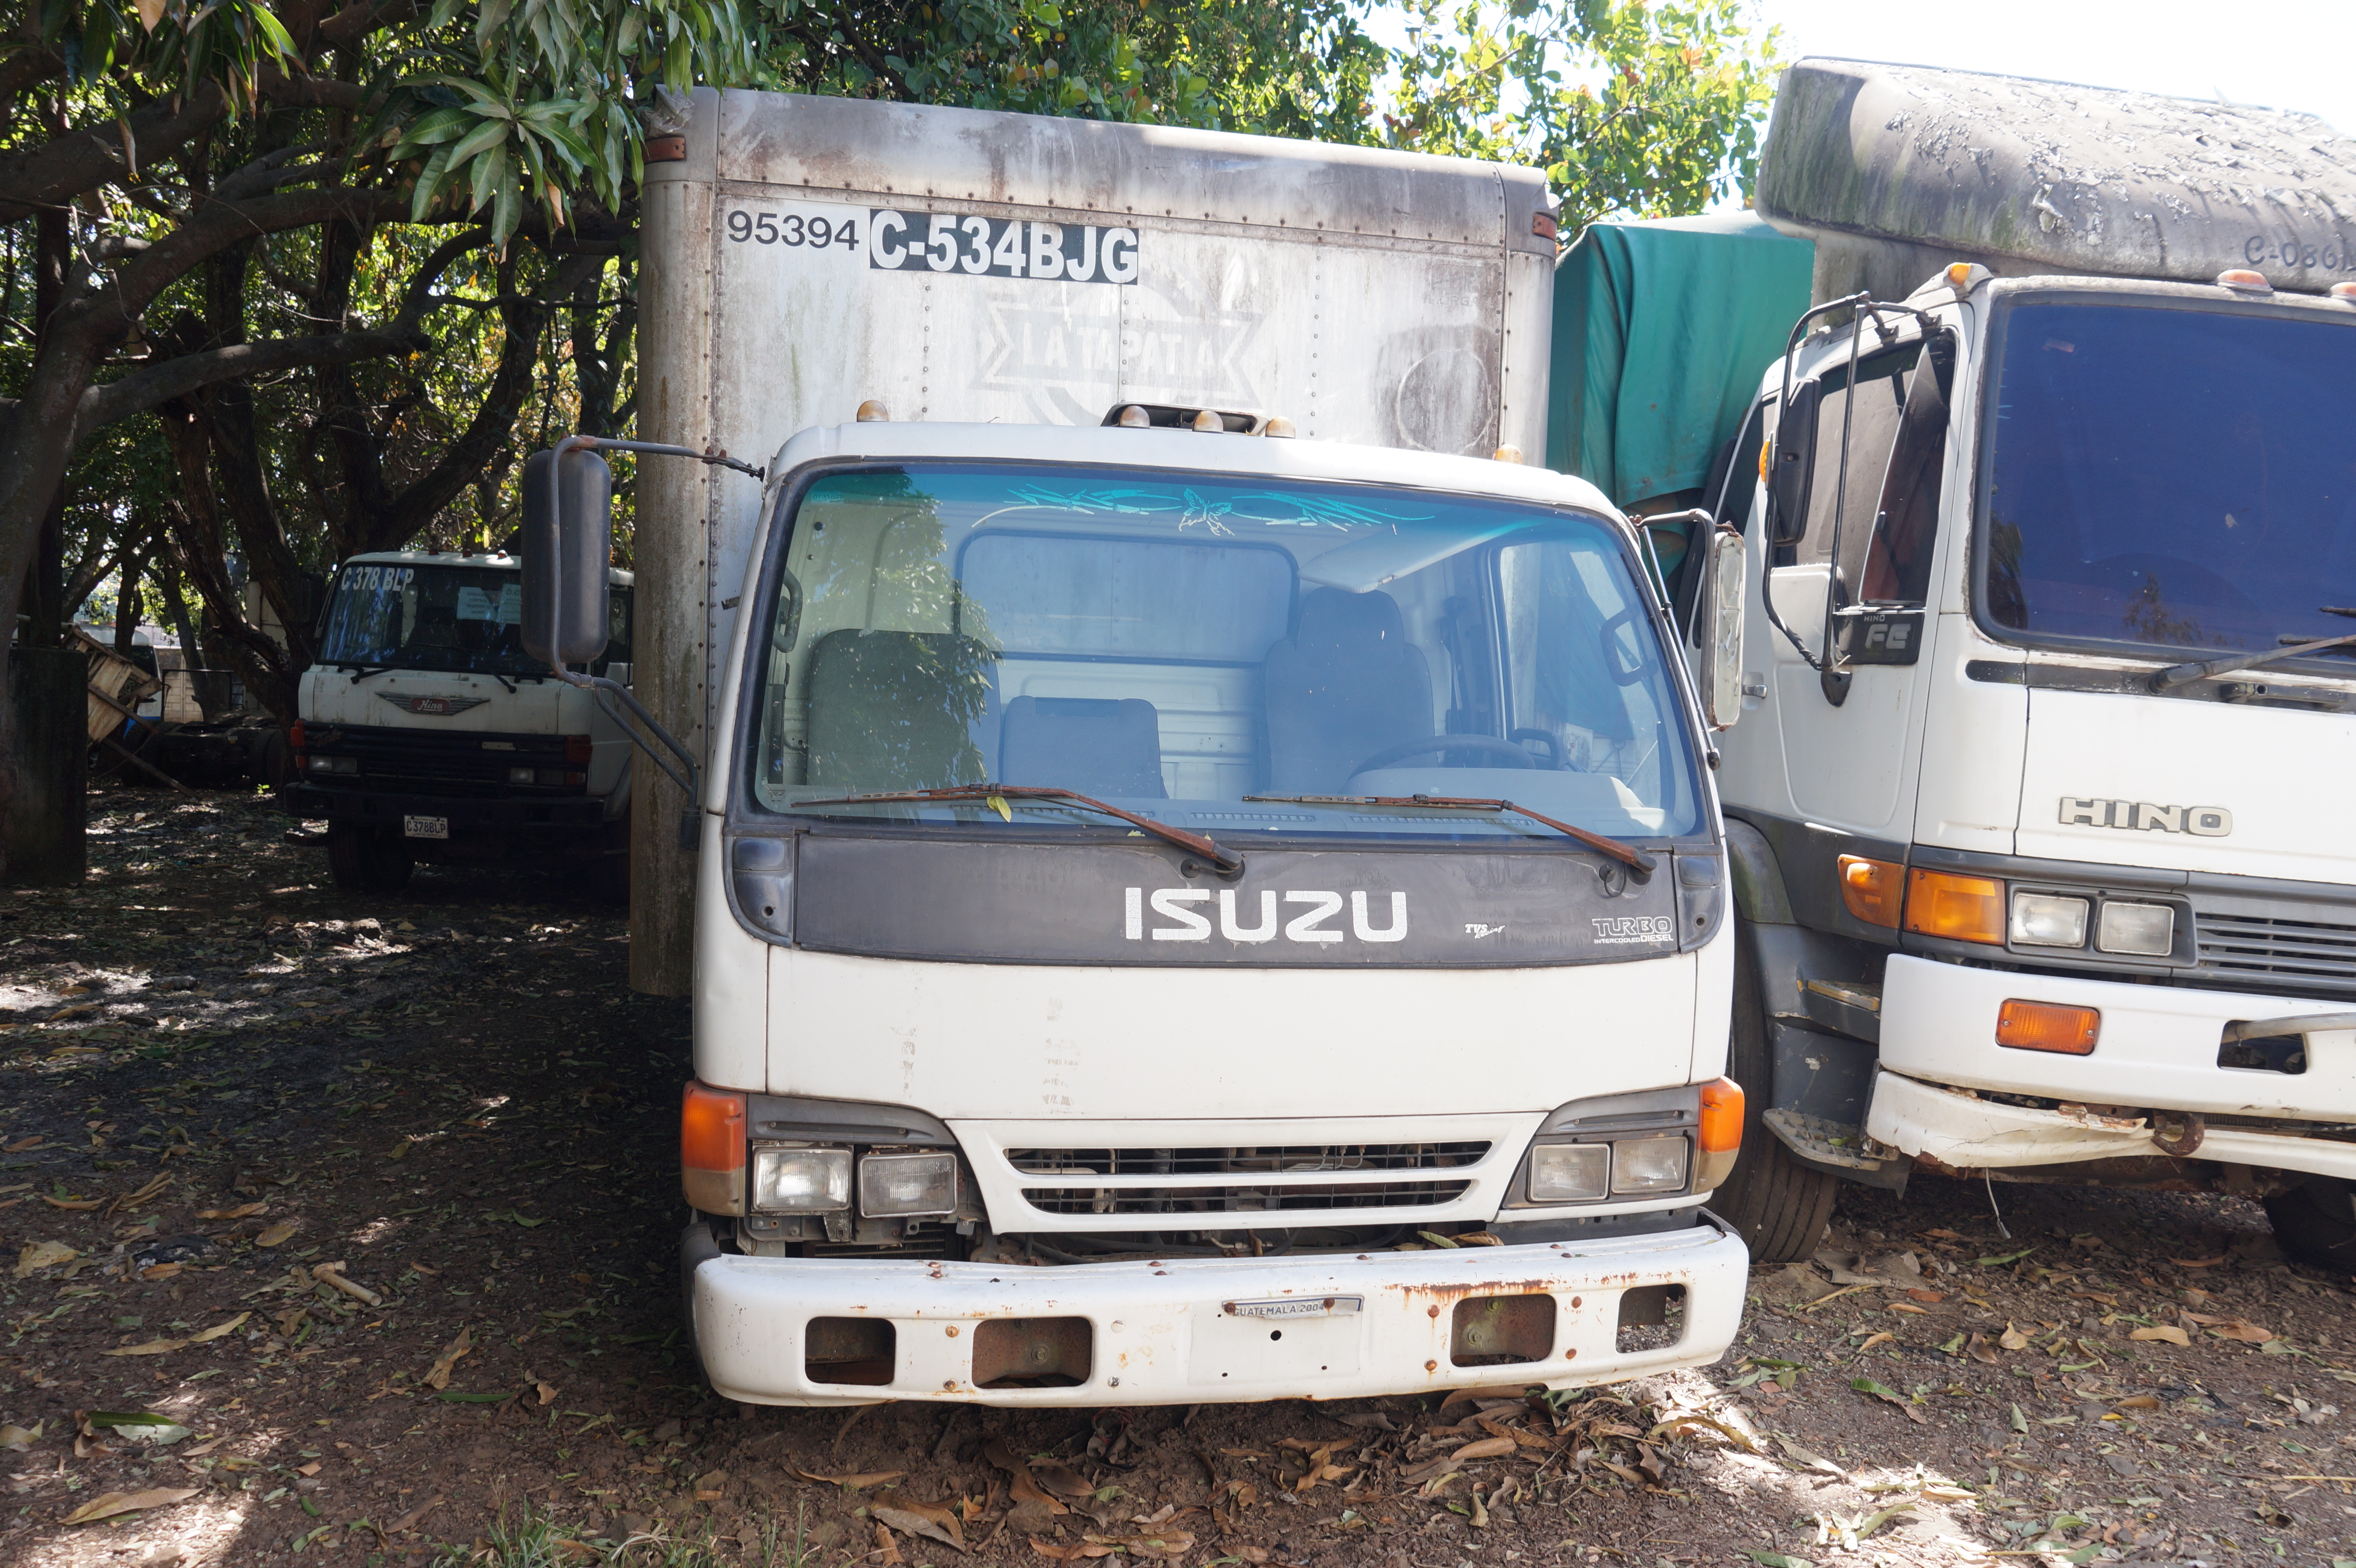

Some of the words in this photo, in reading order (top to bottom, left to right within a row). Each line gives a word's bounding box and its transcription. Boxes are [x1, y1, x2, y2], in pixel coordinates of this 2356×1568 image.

[727, 210, 859, 251] 95394
[870, 209, 1138, 284] C-534BJG
[341, 567, 352, 591] C
[353, 566, 381, 591] 378
[382, 567, 415, 592] BLP
[1865, 623, 1911, 649] FE
[417, 699, 443, 711] Hino
[2059, 797, 2233, 838] HINO
[1124, 886, 1408, 943] ISUZU
[1591, 916, 1672, 936] TURBO
[1464, 923, 1488, 933] TVS
[1474, 925, 1506, 939] Racing
[1640, 934, 1674, 942] DIESEL
[1233, 1305, 1296, 1317] GUATEMALA
[1300, 1302, 1324, 1312] 2004
